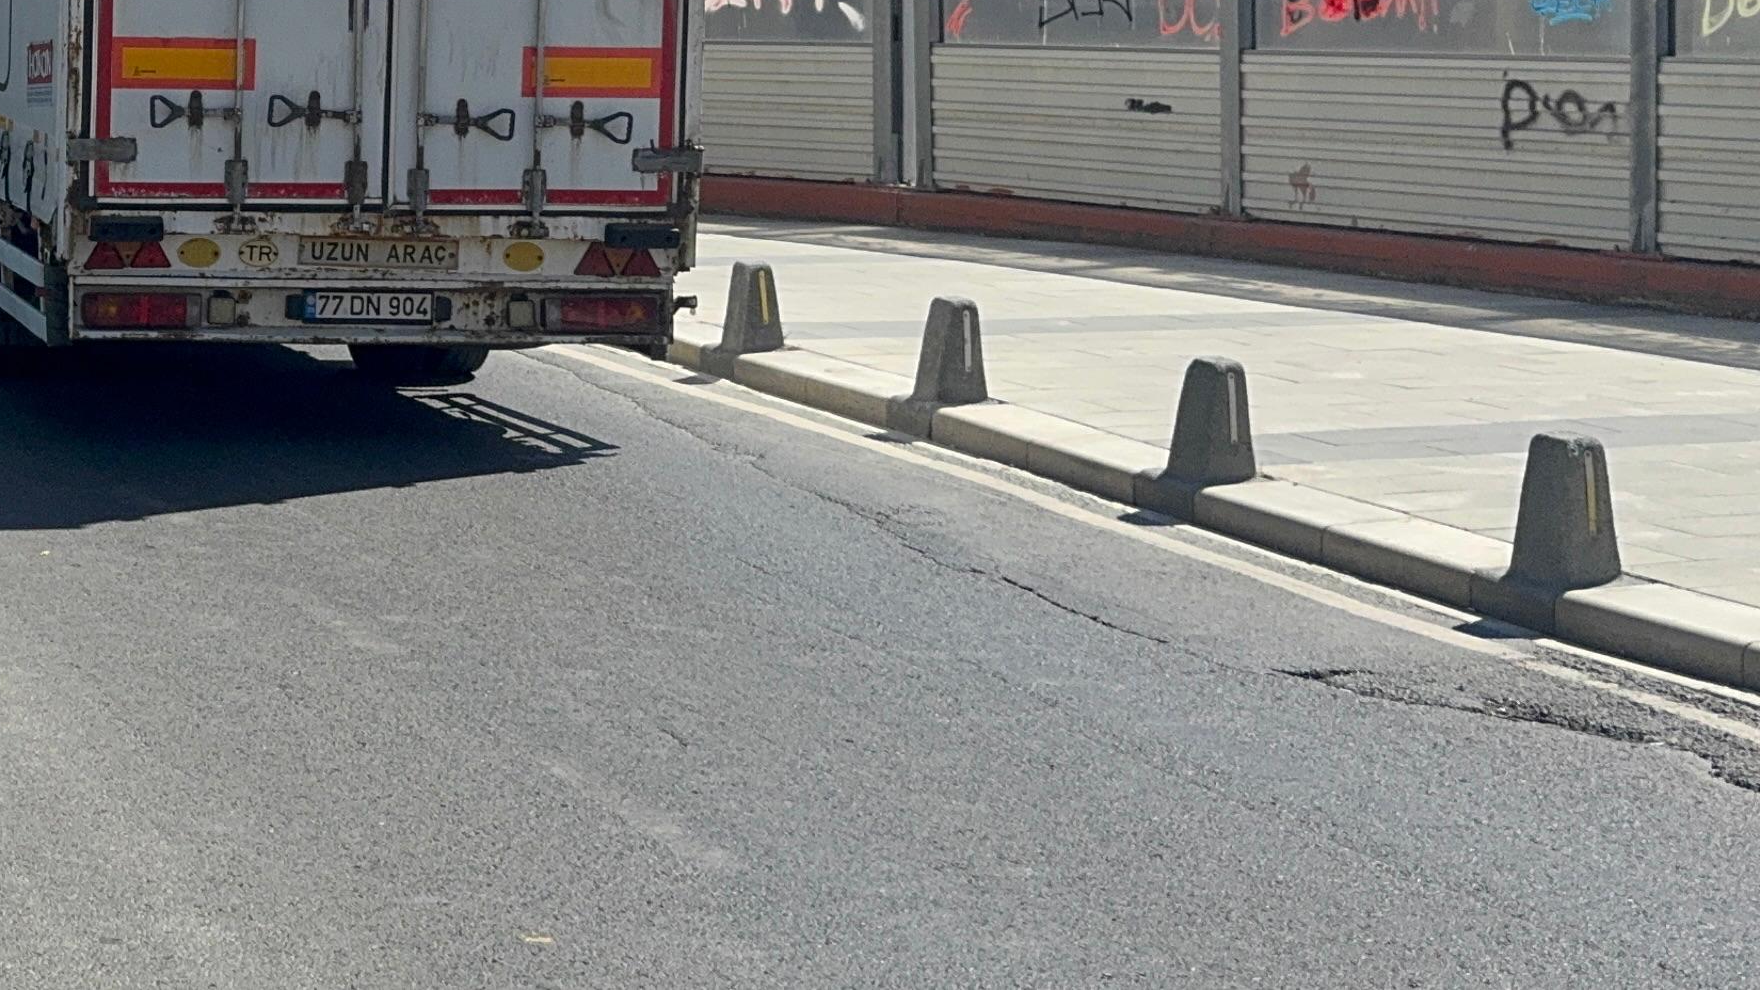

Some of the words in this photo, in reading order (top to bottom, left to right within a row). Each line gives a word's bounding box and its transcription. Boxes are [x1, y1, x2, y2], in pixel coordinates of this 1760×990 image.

[246, 244, 272, 261] TR
[311, 241, 369, 262] UZUN
[386, 244, 446, 265] ARAÇ
[318, 295, 345, 316] 77
[350, 295, 381, 316] DN
[389, 296, 428, 317] 904
